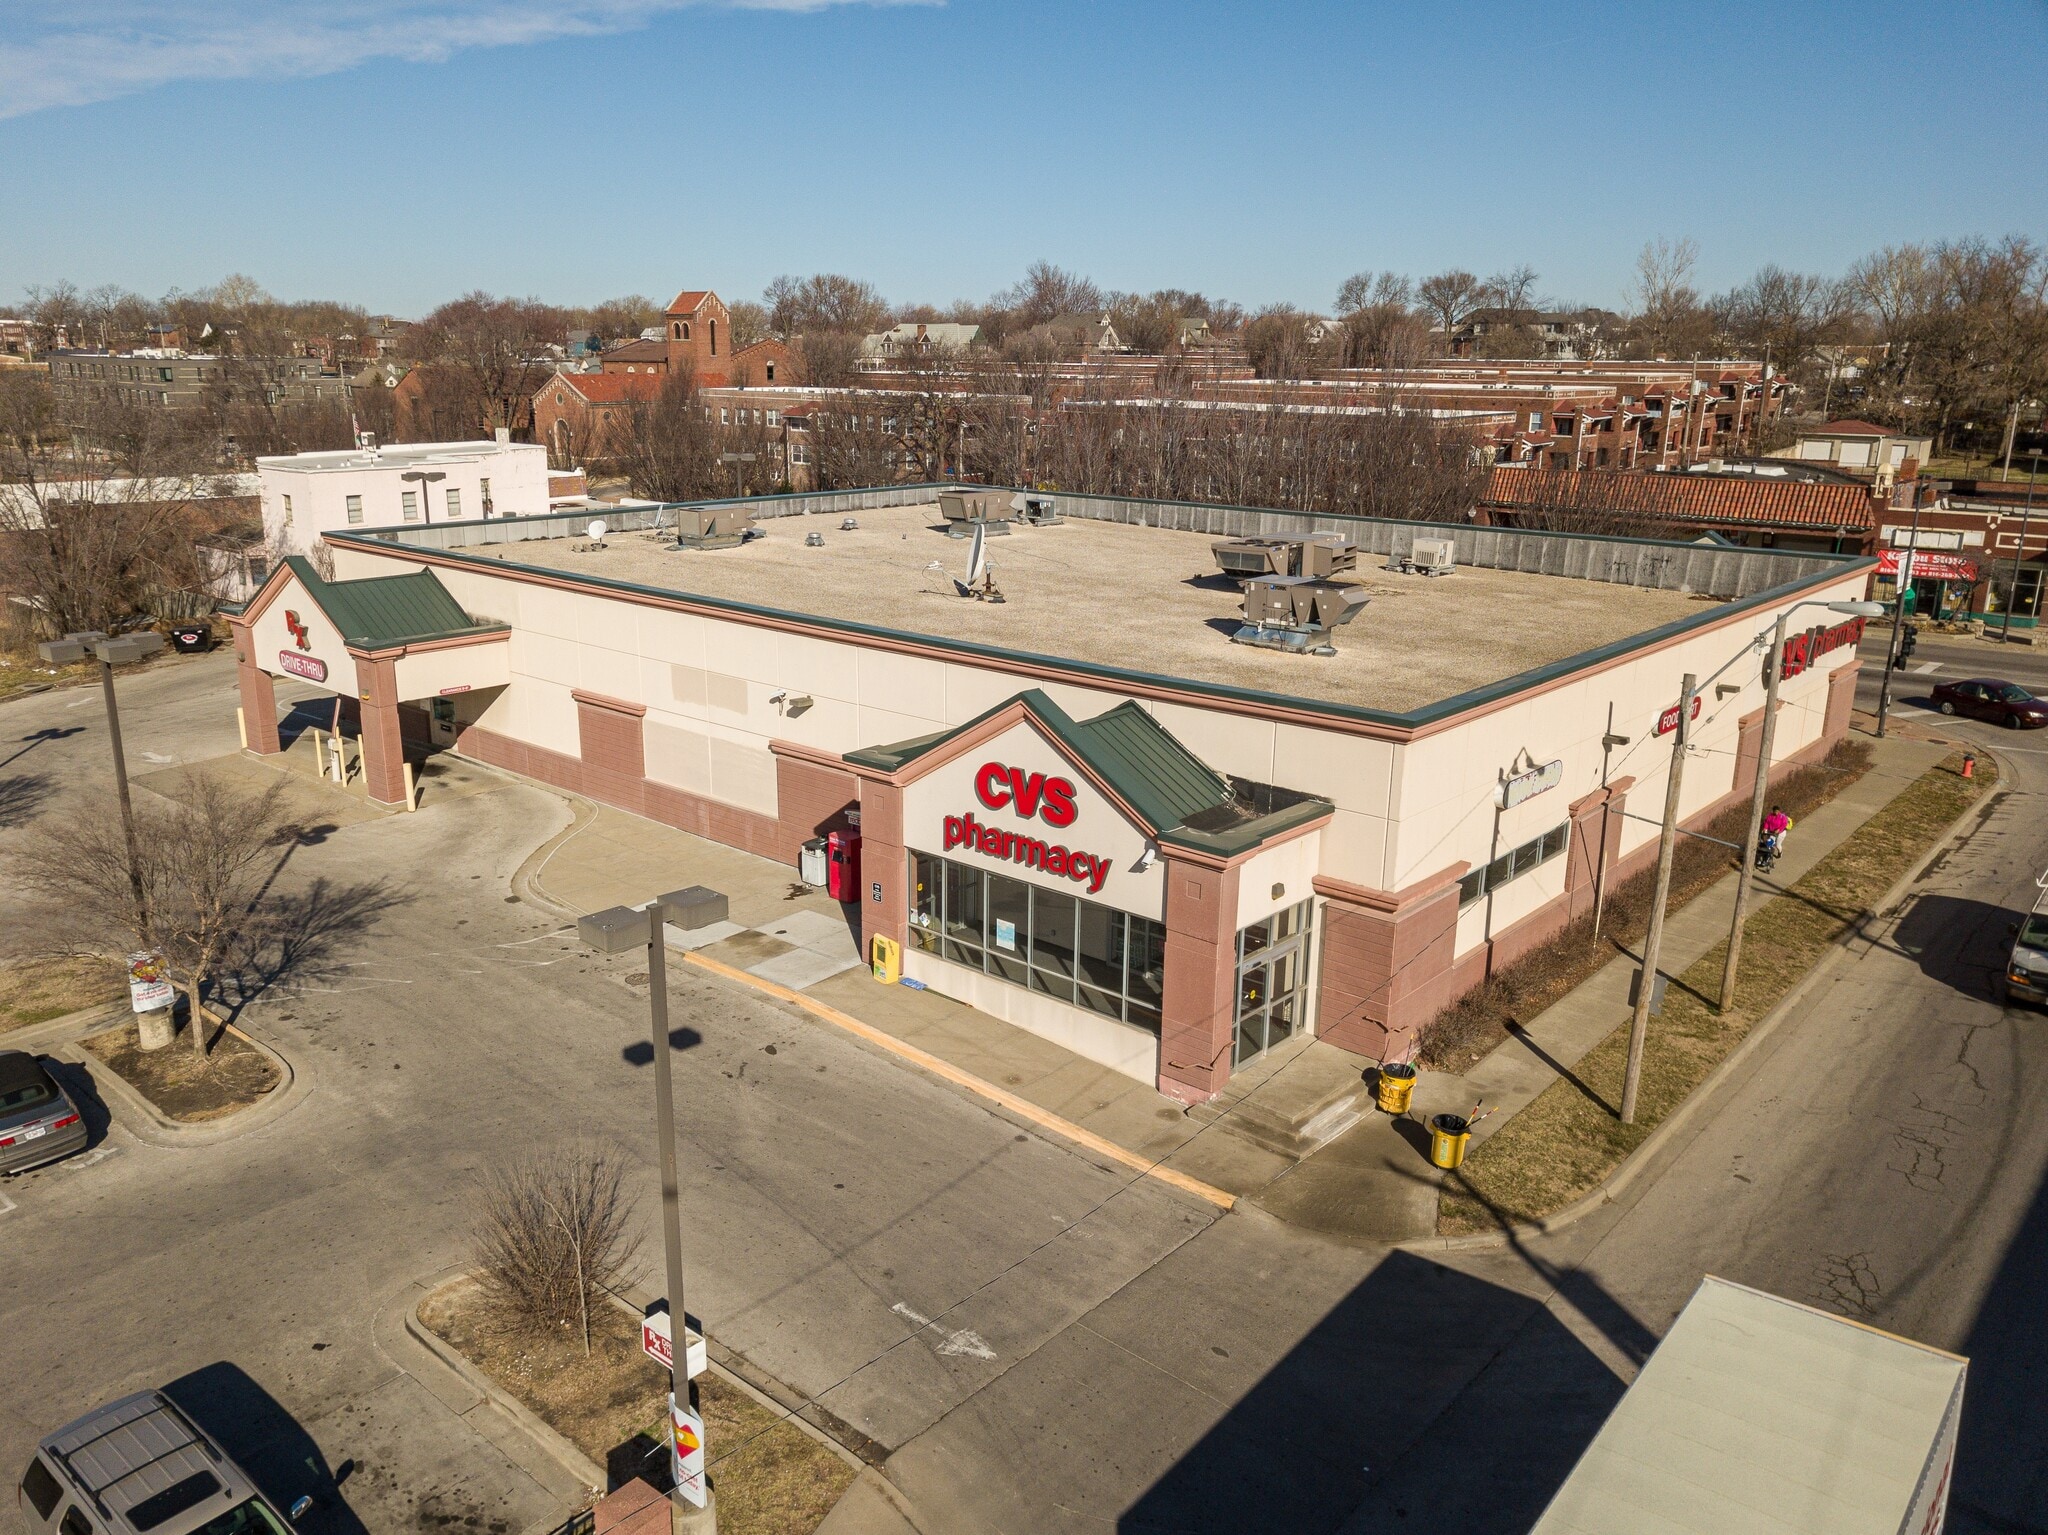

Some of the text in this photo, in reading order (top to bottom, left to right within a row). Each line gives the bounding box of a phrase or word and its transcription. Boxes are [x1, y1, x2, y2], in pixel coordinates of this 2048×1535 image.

[280, 653, 323, 678] DRIVE-THRU
[975, 761, 1078, 828] CVS
[943, 812, 1112, 894] pharmacy
